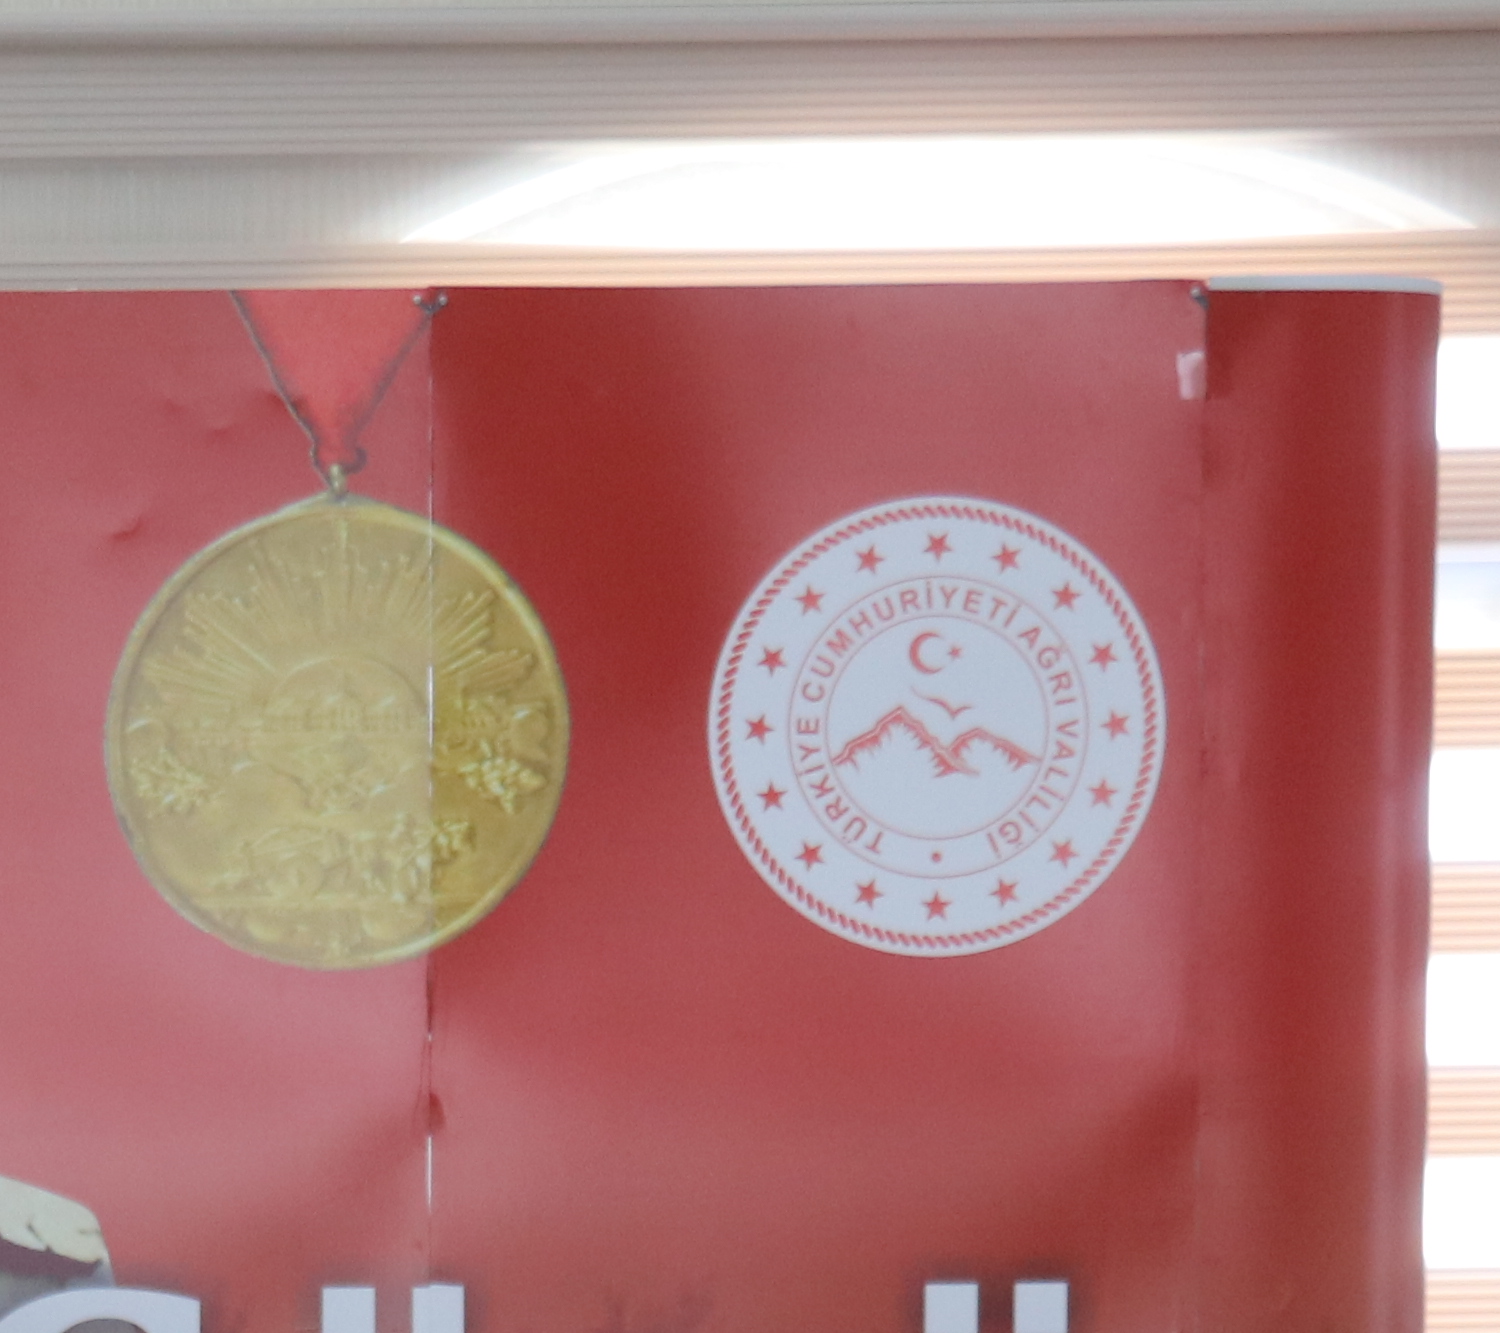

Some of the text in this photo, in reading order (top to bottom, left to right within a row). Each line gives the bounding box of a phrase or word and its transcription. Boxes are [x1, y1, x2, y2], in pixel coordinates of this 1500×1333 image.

[796, 579, 1081, 857] TÜRKİYE CUMHURİYETİ AĞRI VALİLİĞİ
